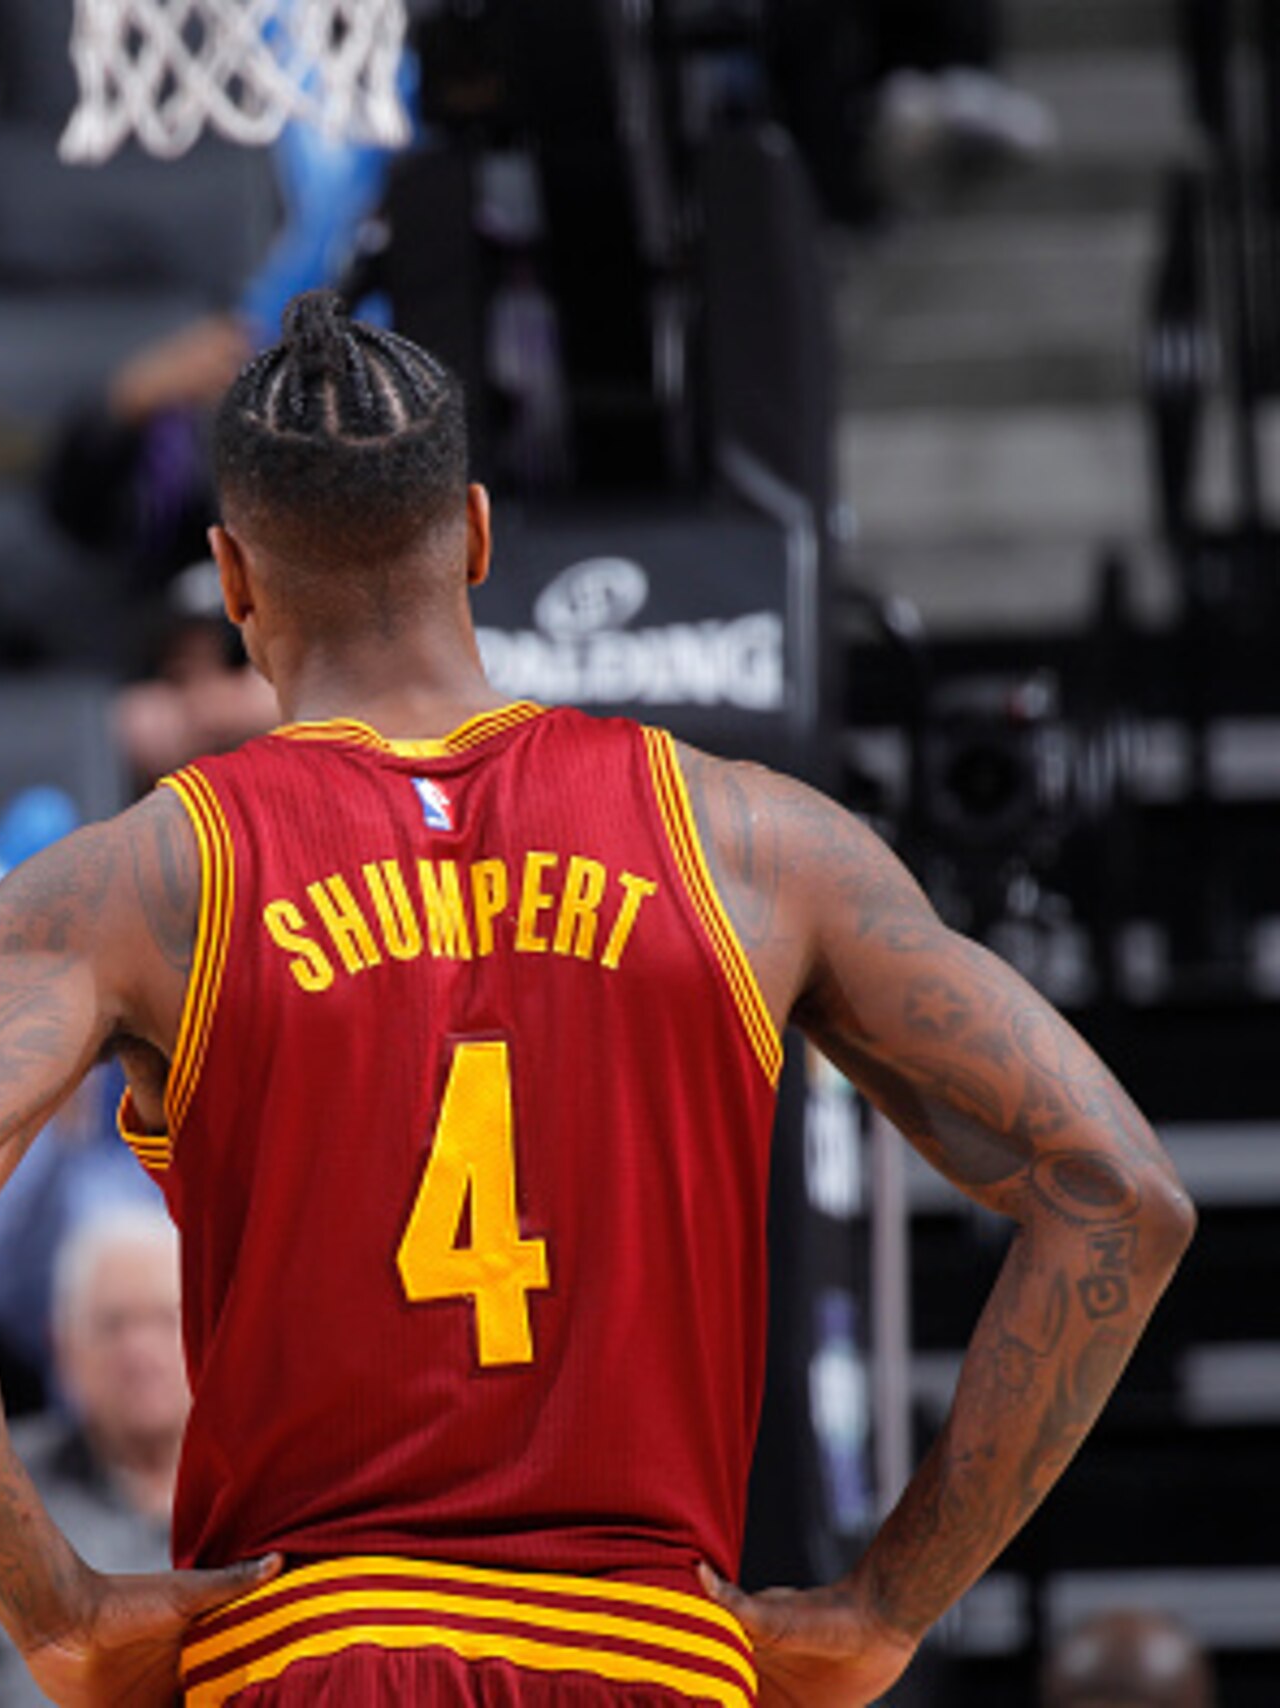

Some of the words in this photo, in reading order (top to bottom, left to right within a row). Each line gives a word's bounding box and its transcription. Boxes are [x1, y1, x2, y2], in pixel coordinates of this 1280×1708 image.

[473, 612, 784, 711] PALDING
[262, 851, 658, 992] SHUMPERT
[396, 1041, 550, 1367] 4
